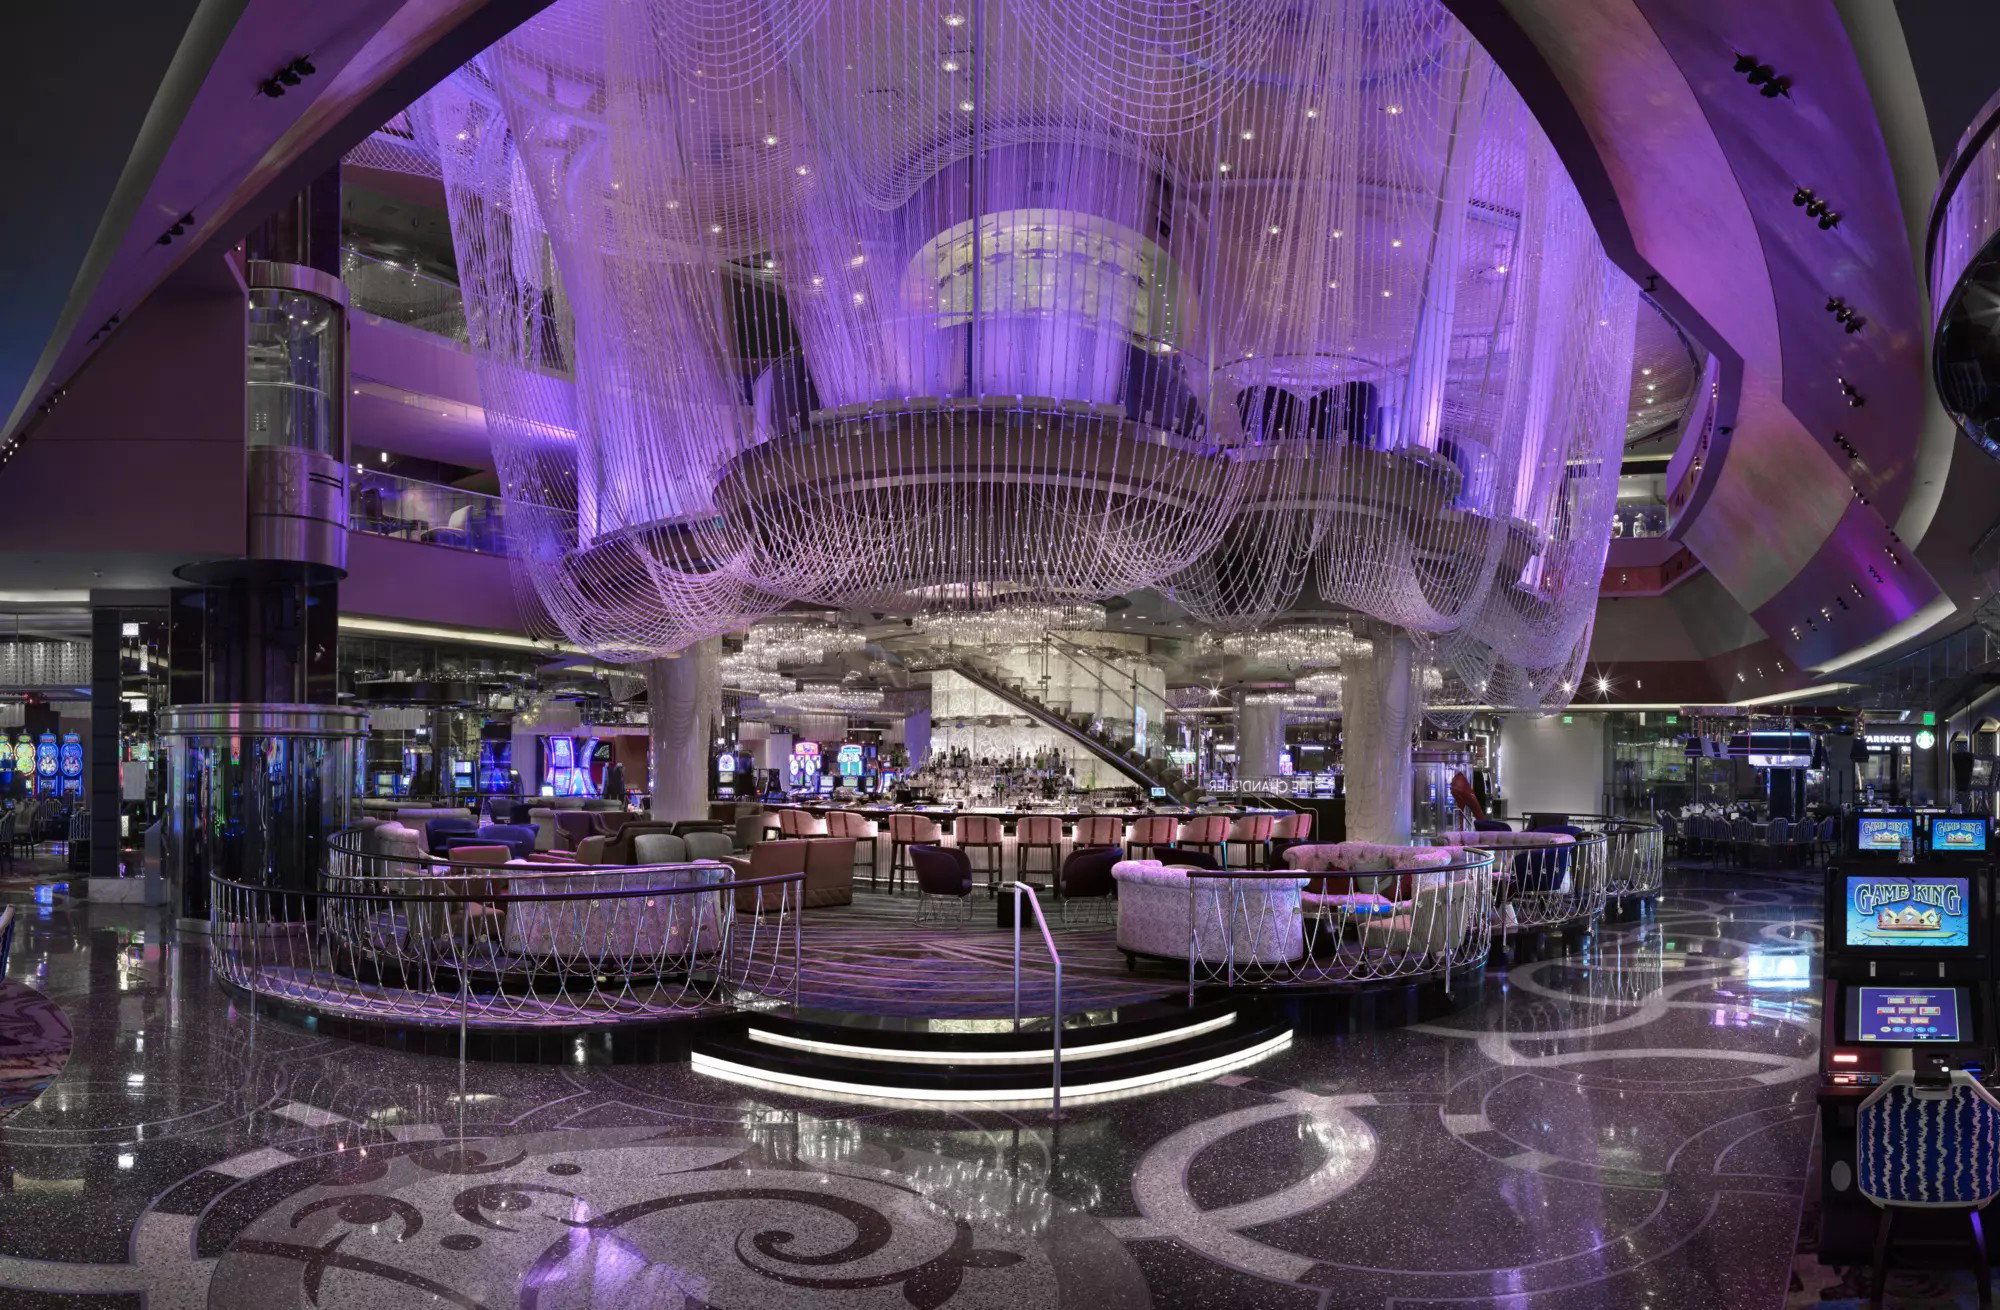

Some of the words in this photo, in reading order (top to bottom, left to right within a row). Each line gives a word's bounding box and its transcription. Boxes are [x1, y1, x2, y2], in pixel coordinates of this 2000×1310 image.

[1864, 735, 1911, 743] ARBUCKS
[1855, 884, 1910, 915] GAME
[1913, 884, 1961, 916] KING
